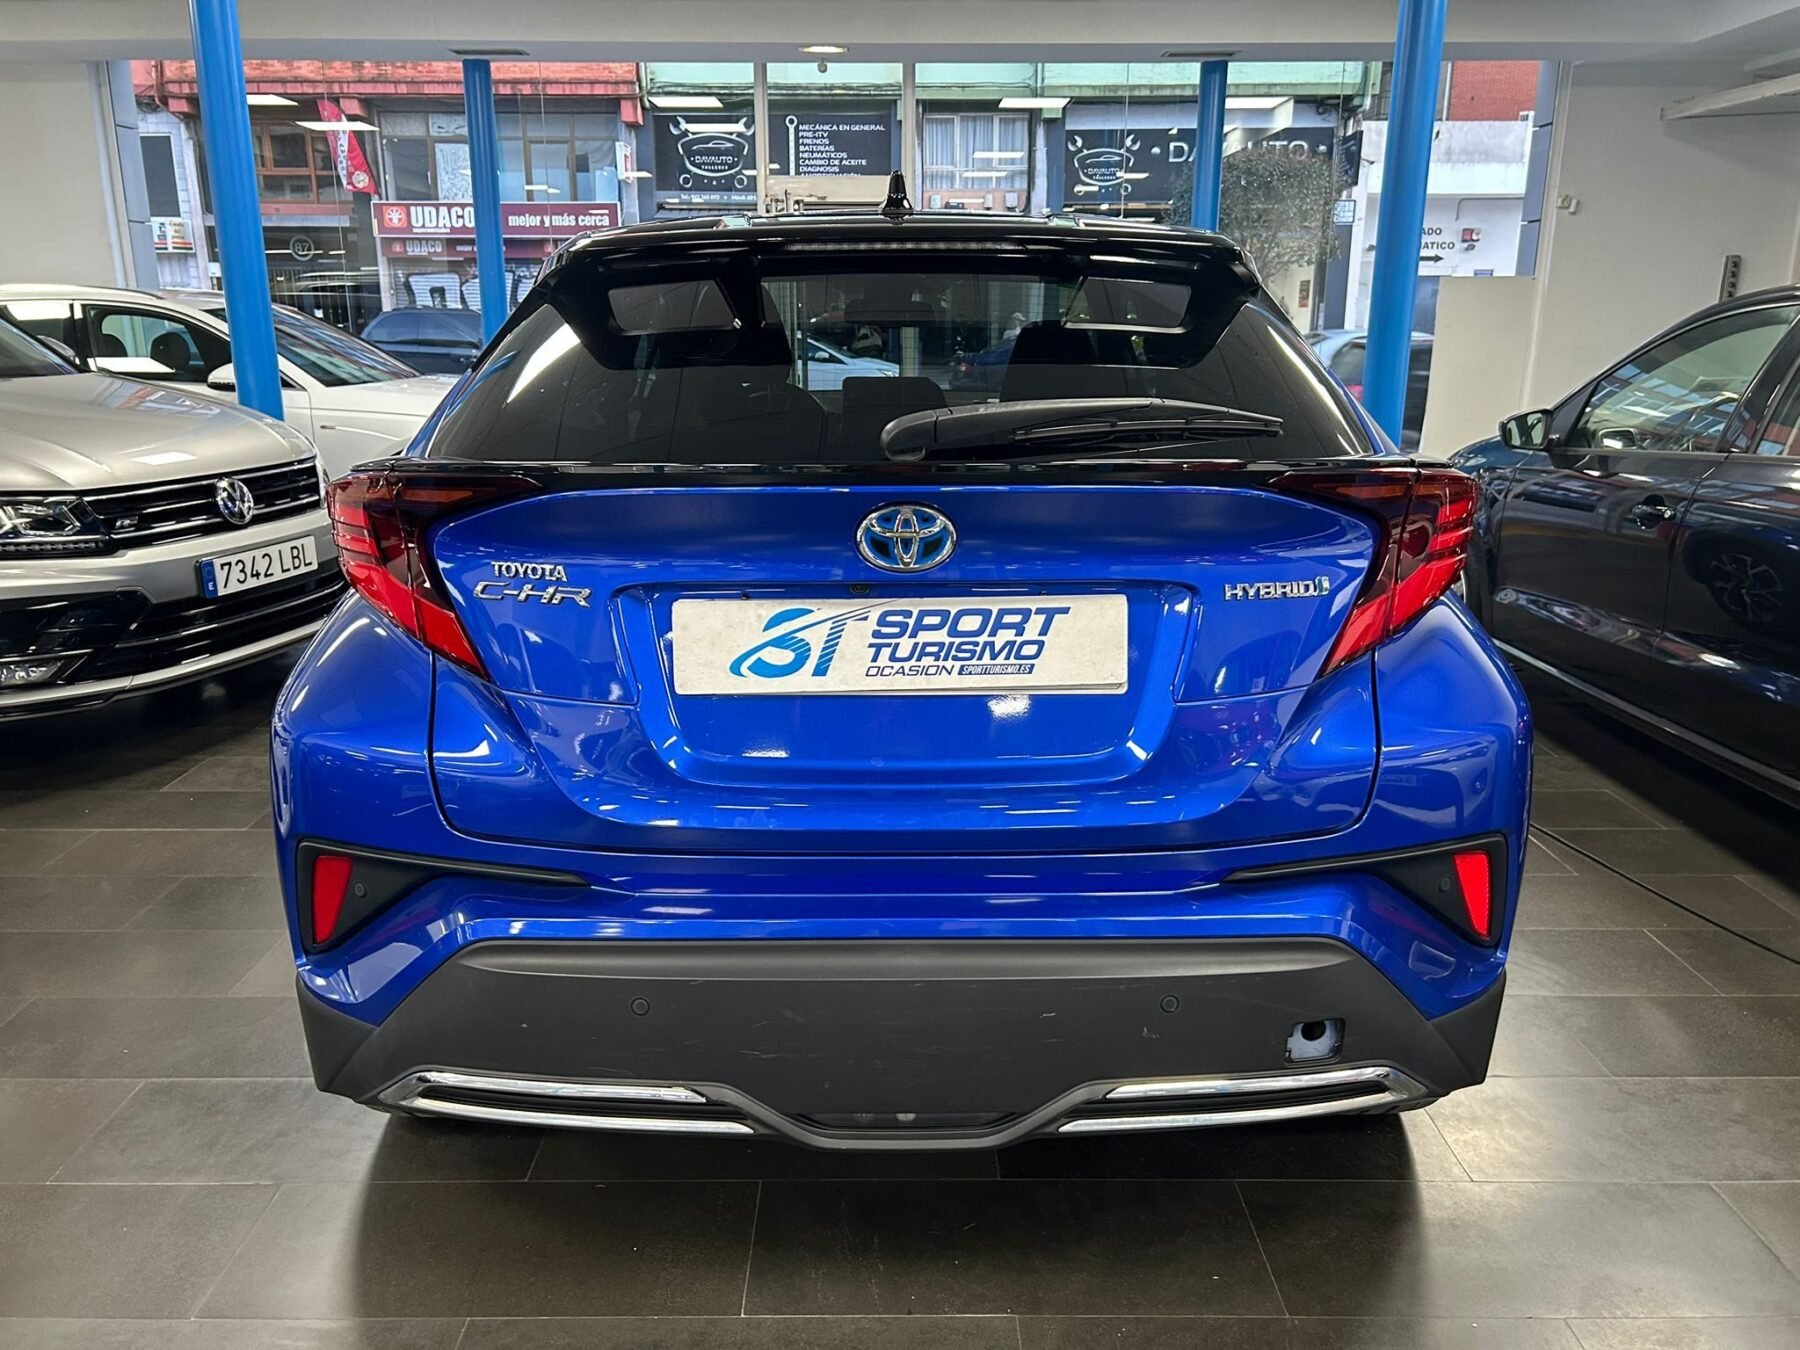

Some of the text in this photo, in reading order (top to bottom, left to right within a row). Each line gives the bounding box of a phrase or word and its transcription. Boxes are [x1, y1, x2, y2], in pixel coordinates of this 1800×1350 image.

[410, 206, 610, 228] UDACO mejor y más cerca
[294, 242, 309, 255] 87
[406, 240, 442, 252] UDACO
[220, 543, 313, 589] 7342 LBL
[491, 561, 568, 582] TOYOTA
[208, 582, 214, 591] E
[473, 581, 591, 608] C-HR
[1225, 580, 1318, 600] HYBRID
[872, 607, 1071, 639] SPORT
[866, 640, 1045, 663] TURISMO
[865, 664, 1032, 677] OCASION SPORTTURISMO.ES
